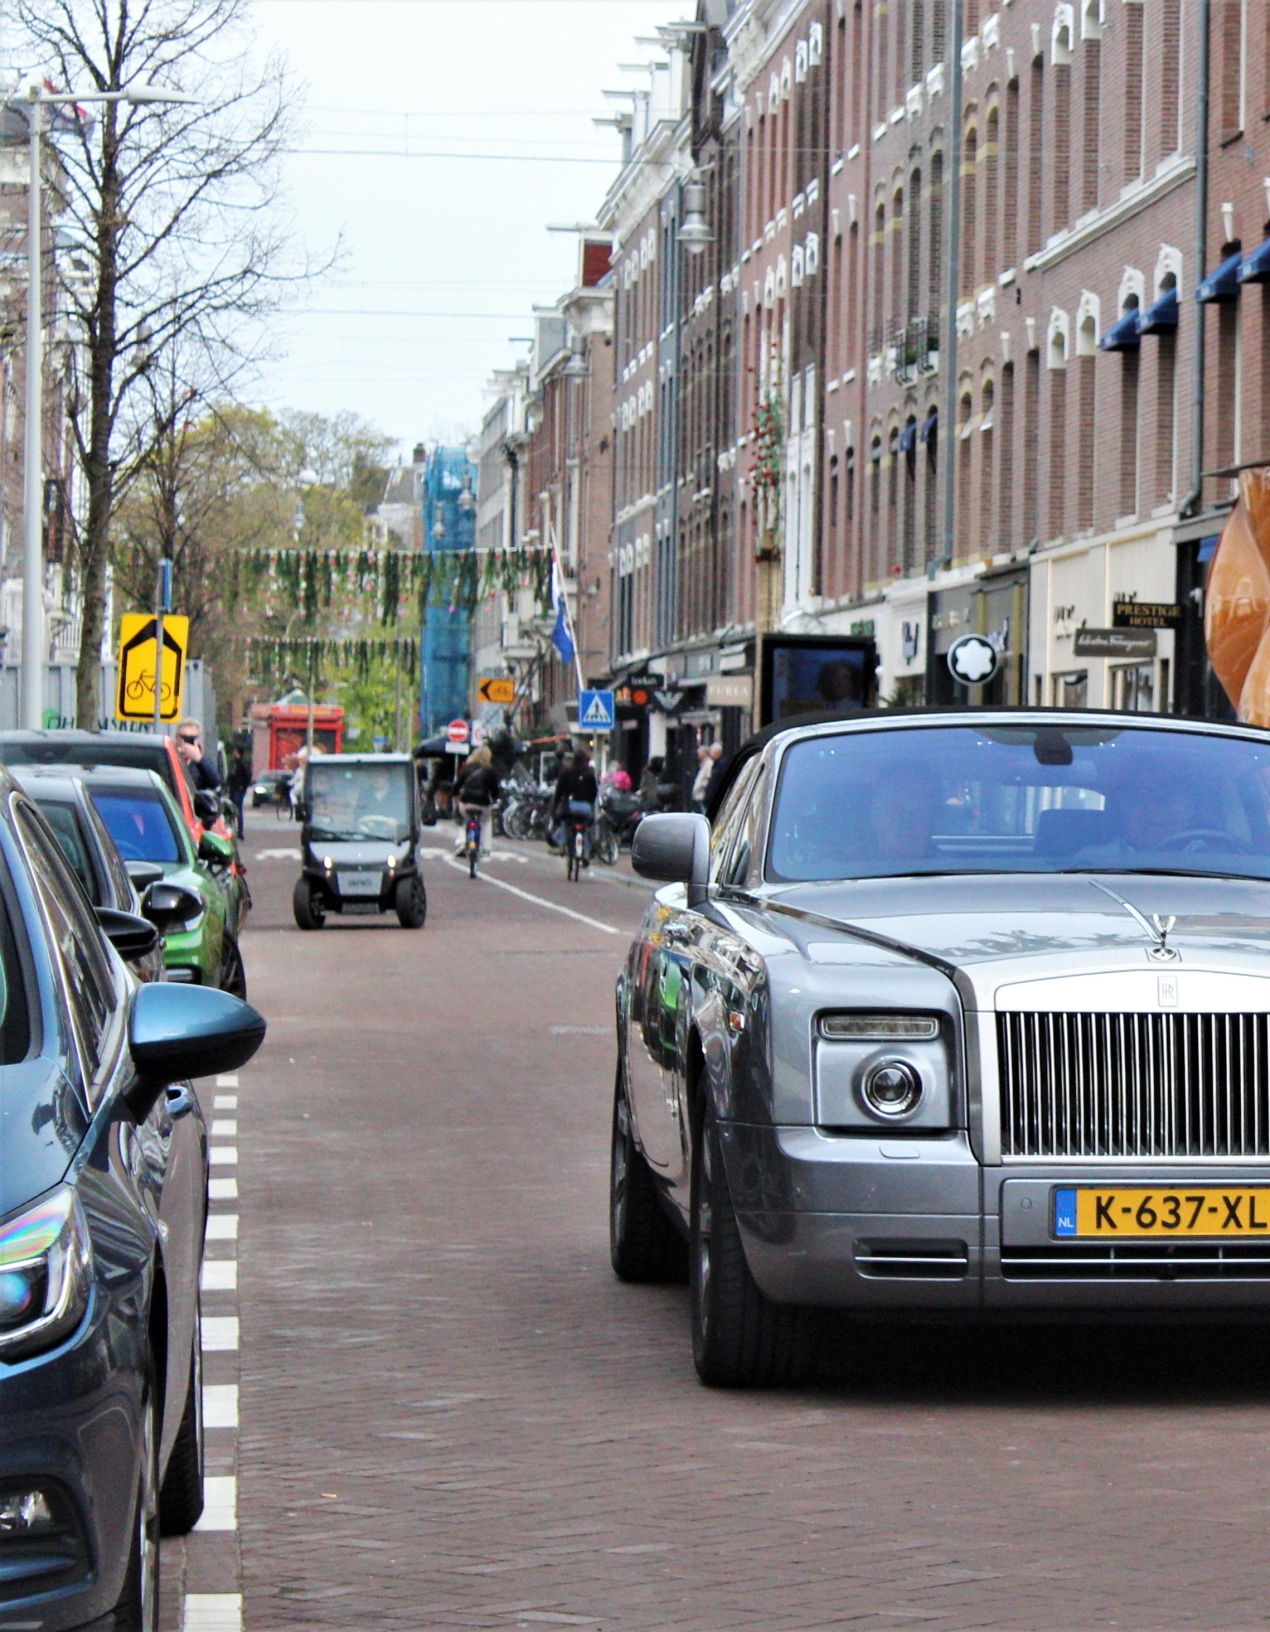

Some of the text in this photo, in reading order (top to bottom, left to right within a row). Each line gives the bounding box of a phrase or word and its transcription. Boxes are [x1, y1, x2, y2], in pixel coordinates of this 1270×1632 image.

[1117, 604, 1180, 615] PRESTIGE
[1129, 617, 1168, 627] HOTEL
[1095, 1195, 1268, 1229] K-637-XL
[1057, 1216, 1075, 1228] NL
